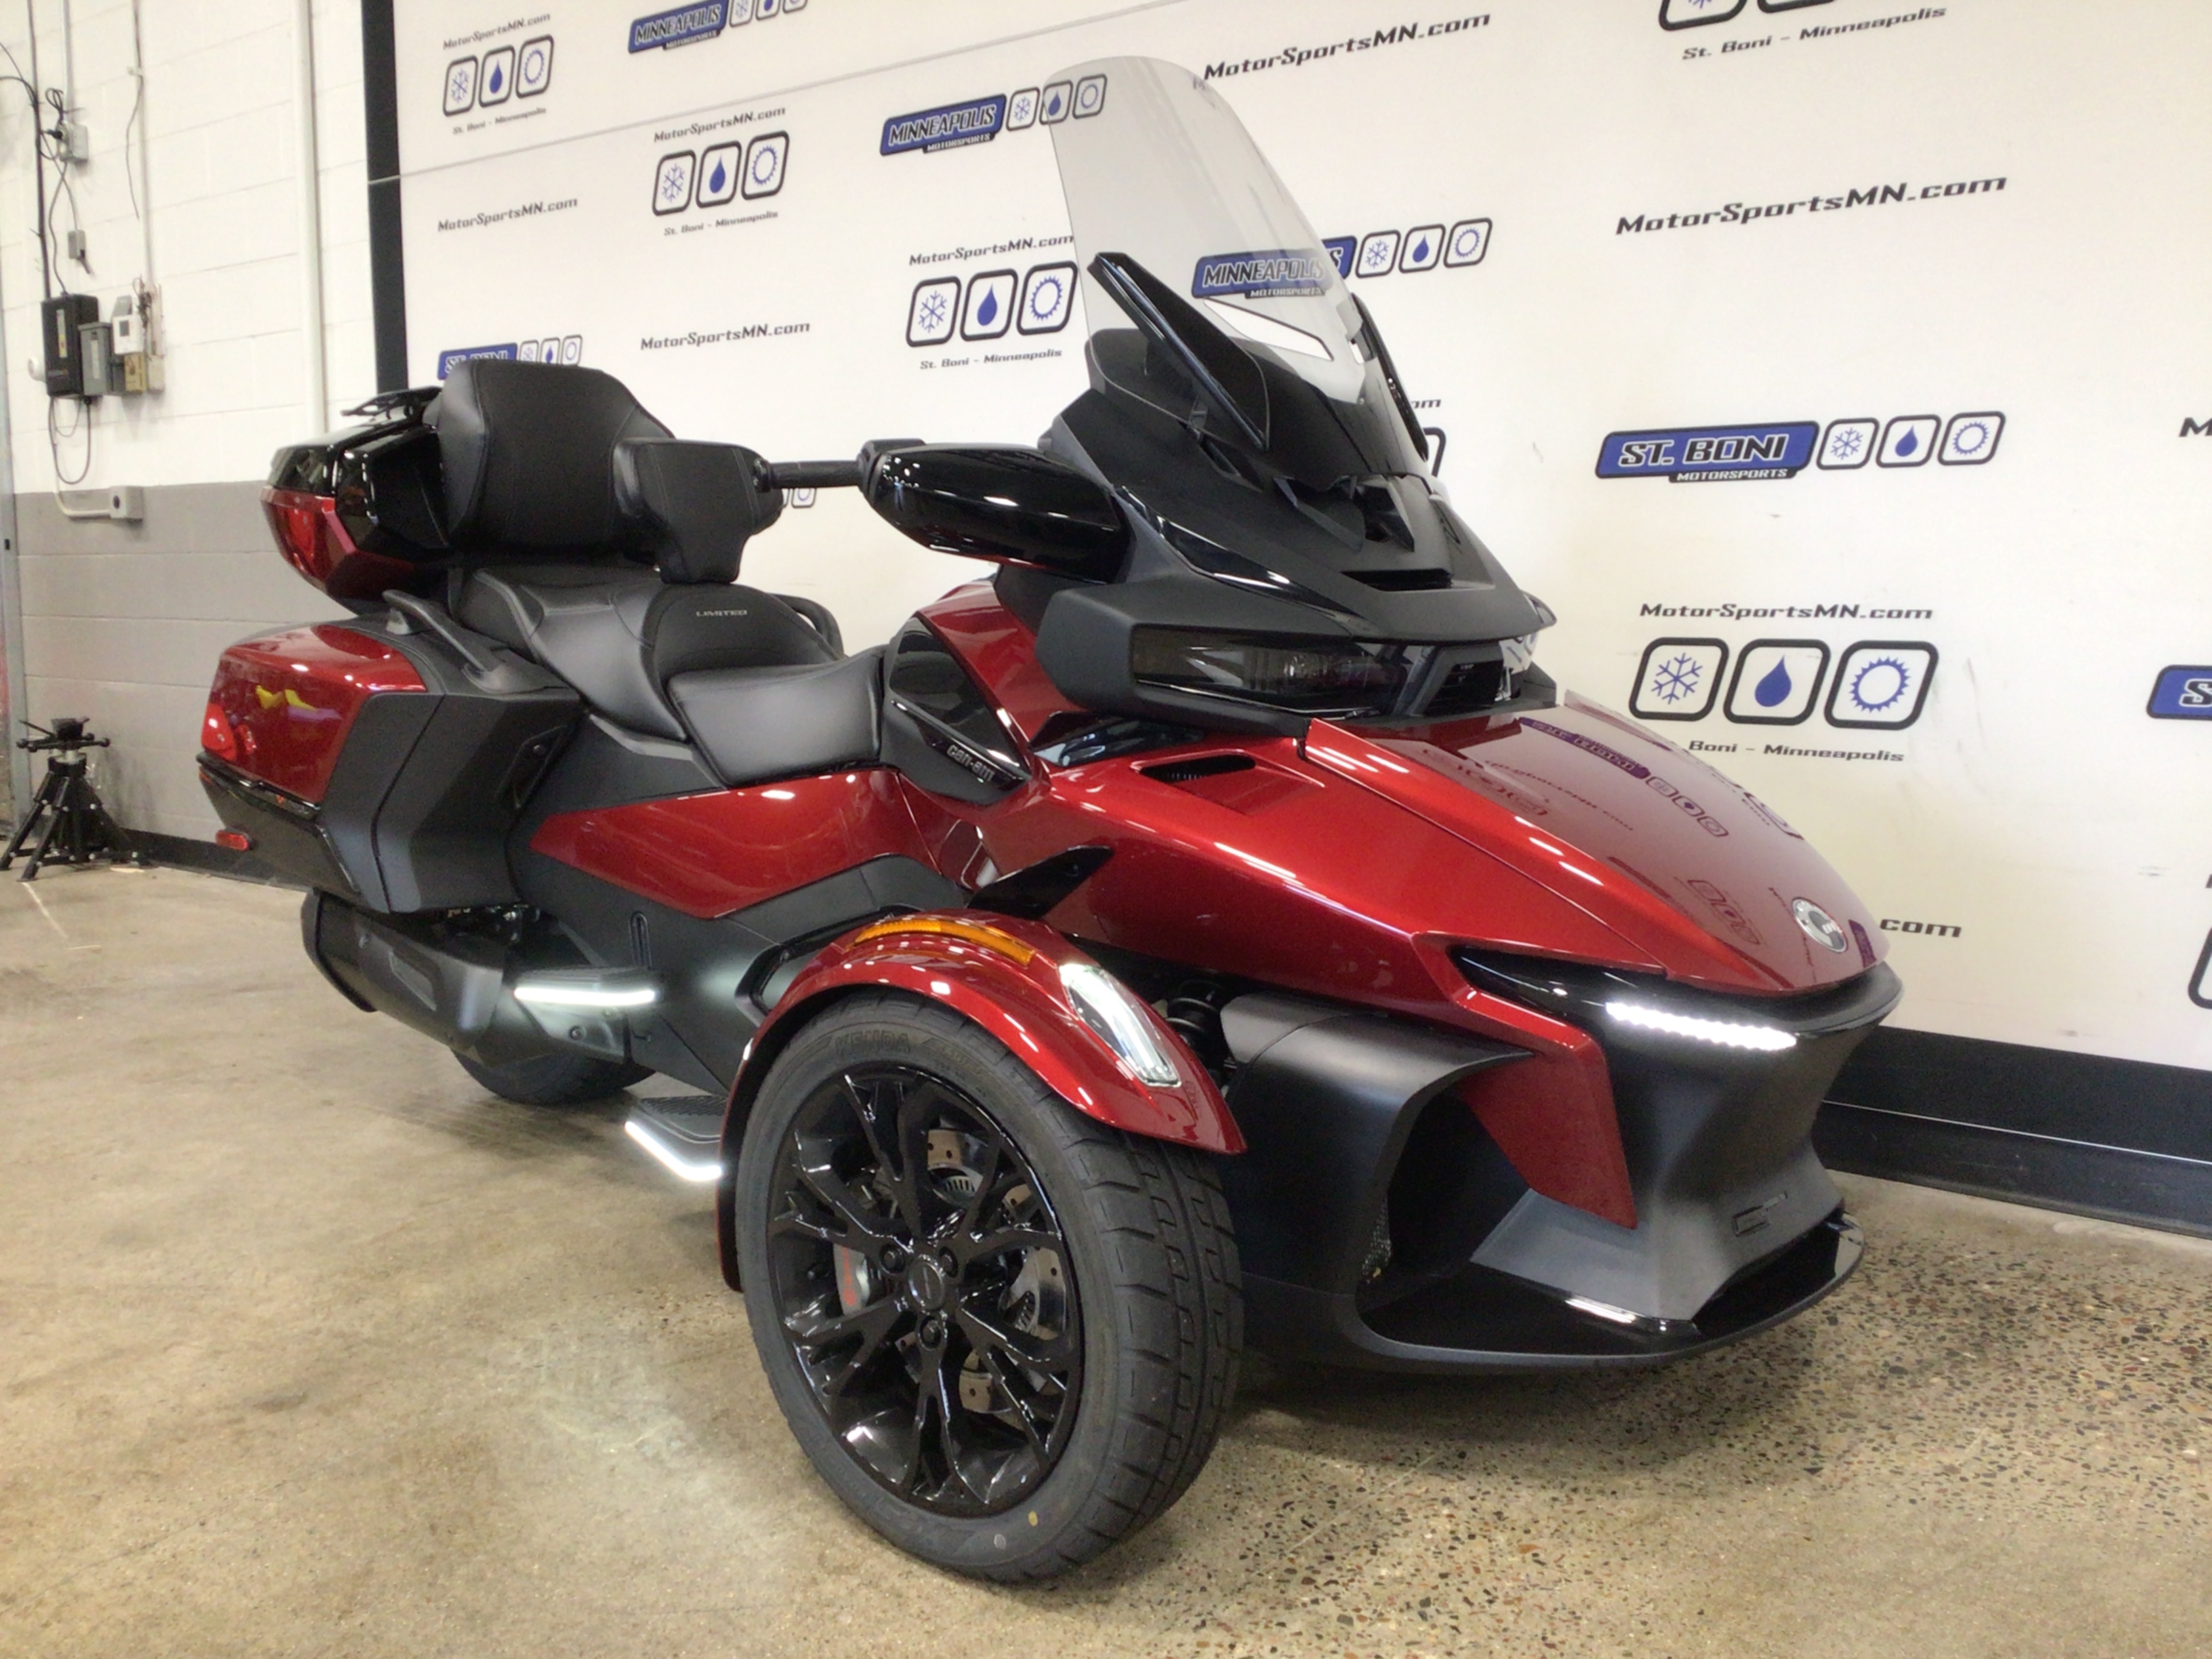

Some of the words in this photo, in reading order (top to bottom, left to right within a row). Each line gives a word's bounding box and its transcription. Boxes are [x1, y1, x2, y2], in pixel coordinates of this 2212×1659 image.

[443, 13, 551, 50] MotorSportsMN.com
[634, 3, 722, 45] MINNEAPOLIS
[1682, 47, 1712, 60] St.
[1721, 35, 1773, 54] Boni
[1799, 6, 1947, 41] Minneapolis
[1204, 13, 1491, 81] MotorSportsMN.com
[653, 106, 787, 143] MotorSportsMN.com
[888, 104, 997, 146] MINNEAPOLIS
[926, 132, 991, 152] MOTORSPORTS
[437, 197, 579, 233] MotorSportsMN.com
[1615, 176, 2008, 236] MotorSportsMN.com
[663, 226, 678, 237] St.
[680, 222, 705, 234] Boni
[715, 210, 779, 228] Minneapolis
[908, 234, 1074, 266] MotorSportsMN.com
[1202, 259, 1326, 288] MINNEAPOLIS
[1250, 287, 1323, 298] MOTORSPORTS
[640, 322, 811, 352] MotorSportsMN.com
[919, 360, 938, 370] St.
[941, 356, 970, 369] Boni
[983, 348, 1063, 365] Minneapolis
[1618, 440, 1675, 466] ST.
[1682, 434, 1789, 465] BONI
[1676, 468, 1789, 482] MOTORSPORTS
[1639, 602, 1933, 621] MotorSportsMN.com
[946, 744, 996, 782] can-am
[1687, 739, 1738, 754] Boni
[1763, 743, 1905, 763] Minneapolis
